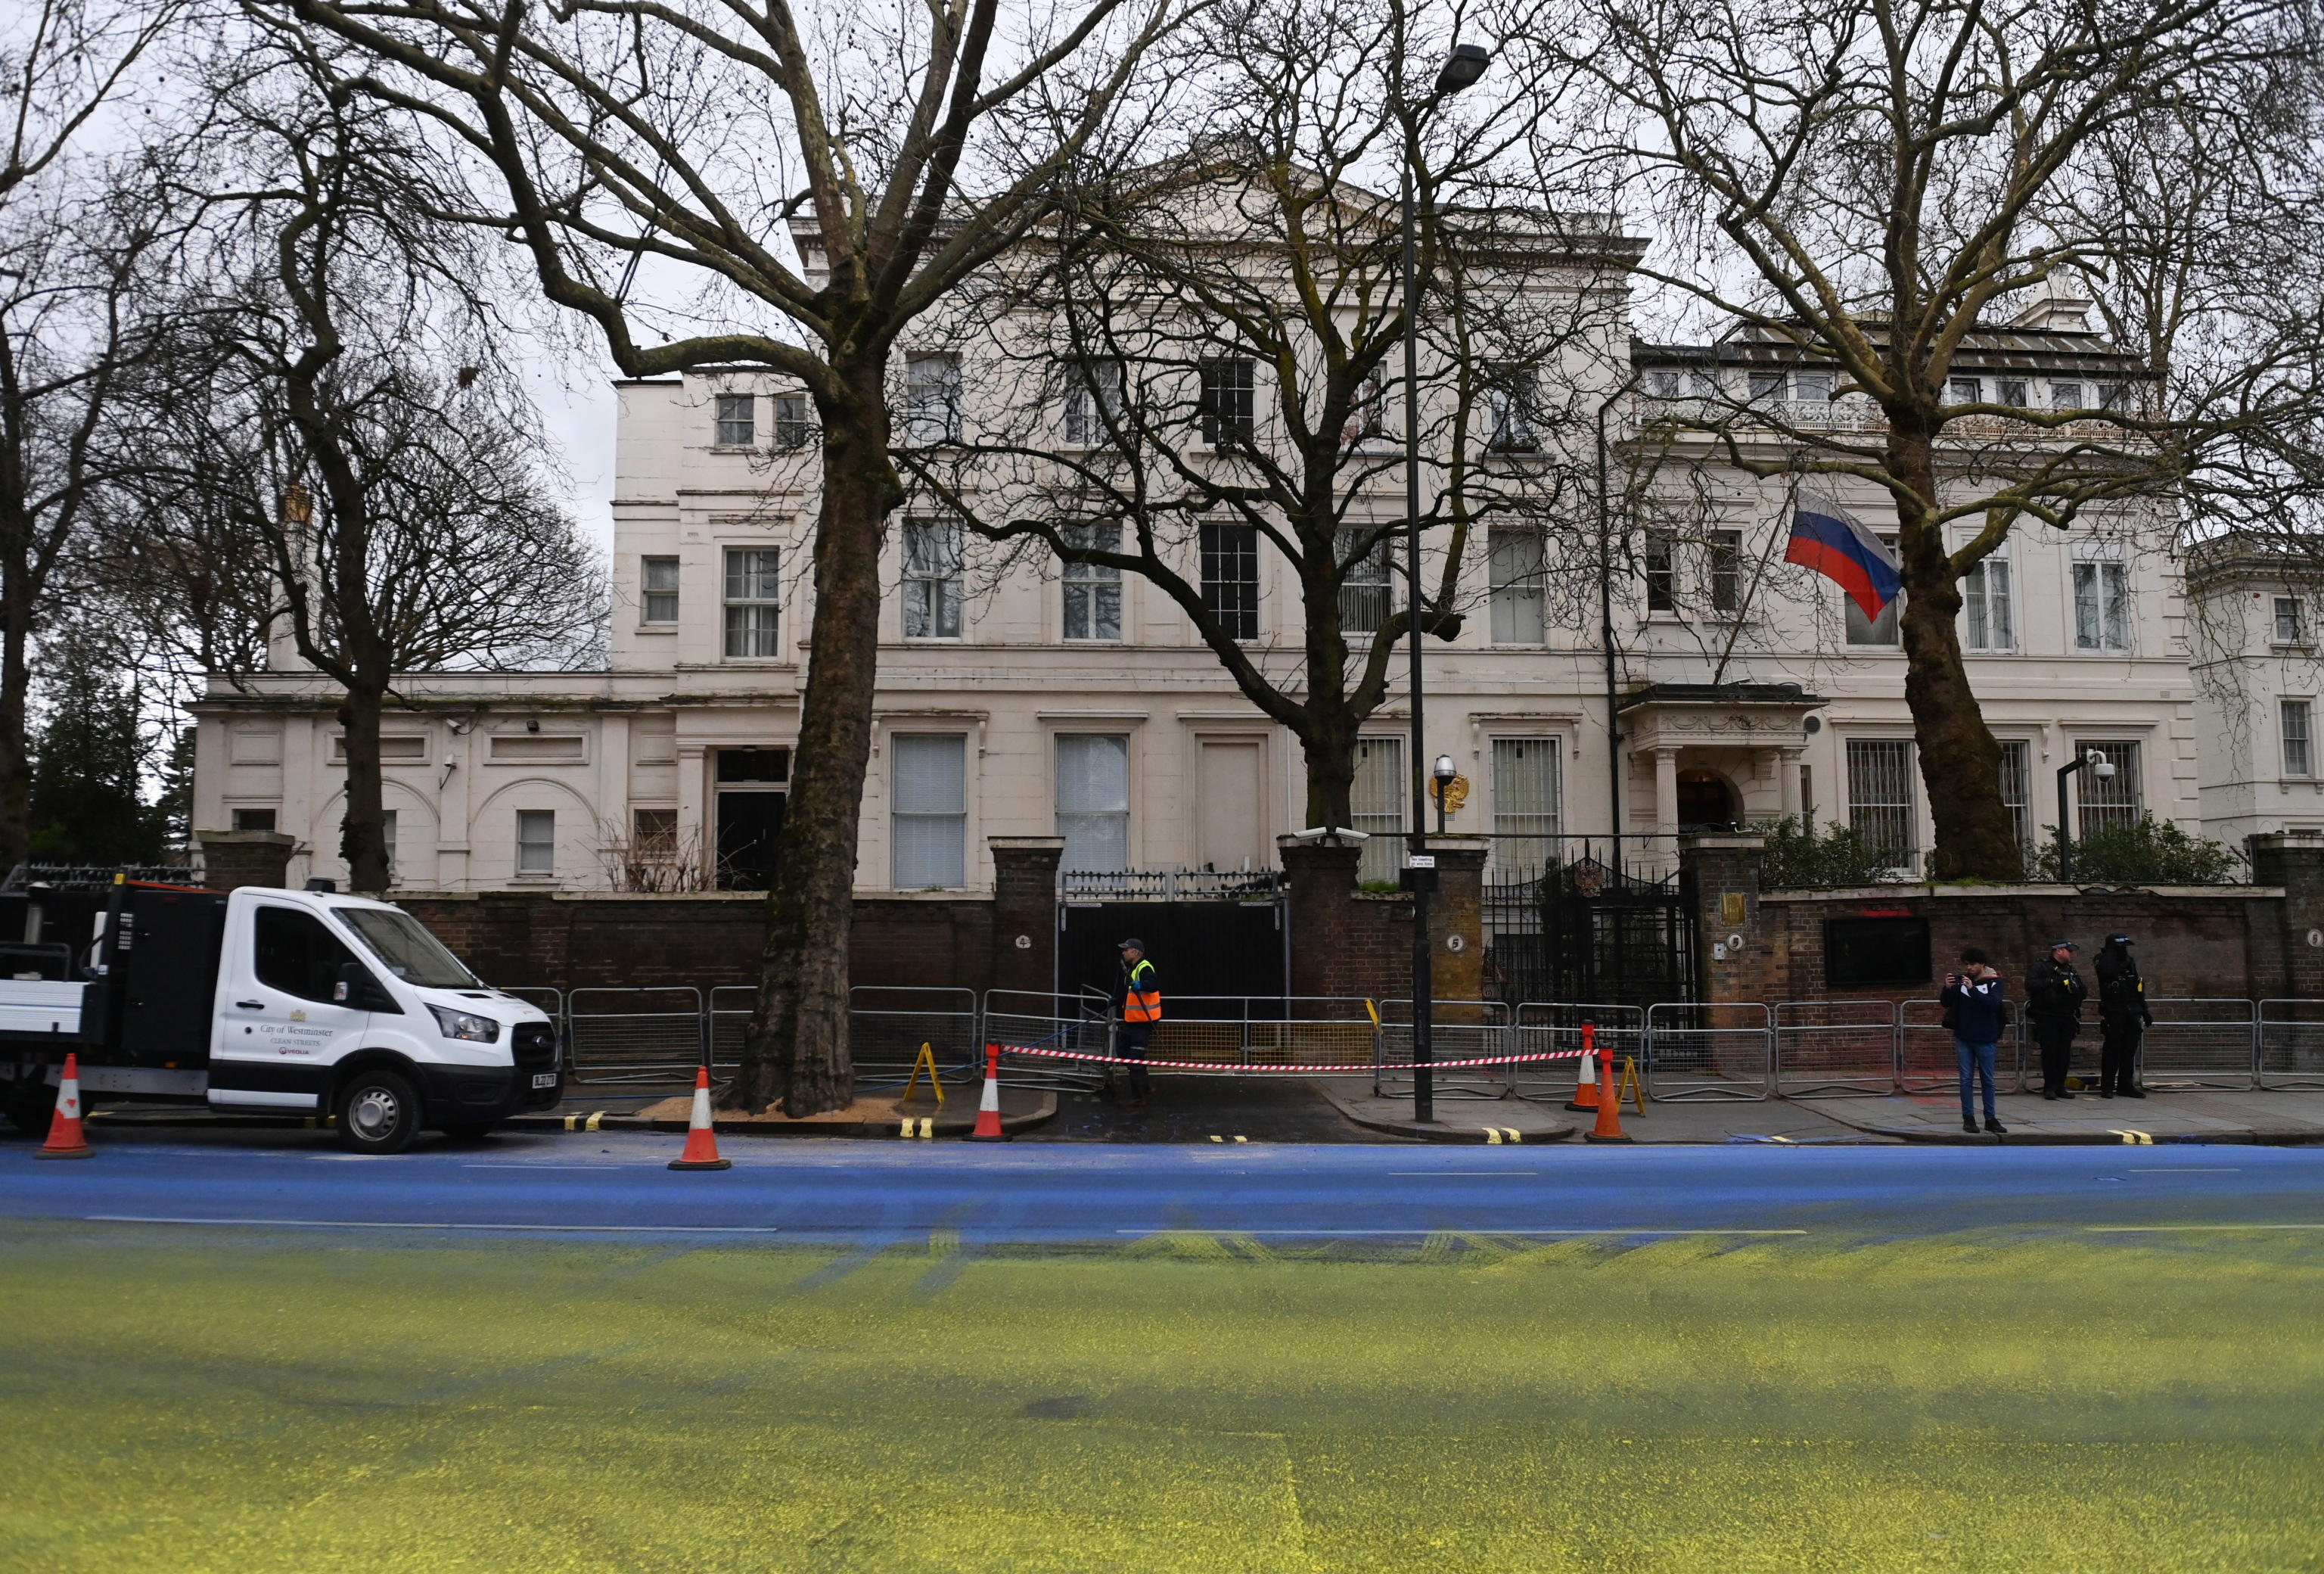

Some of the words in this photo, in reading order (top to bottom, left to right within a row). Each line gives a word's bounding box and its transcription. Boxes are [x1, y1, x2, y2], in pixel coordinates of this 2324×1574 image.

[1019, 938, 1027, 948] 4
[1452, 938, 1459, 948] 5
[2312, 934, 2318, 944] 5
[260, 1025, 275, 1035] City
[277, 1025, 285, 1034] of
[287, 1026, 333, 1037] Westminster
